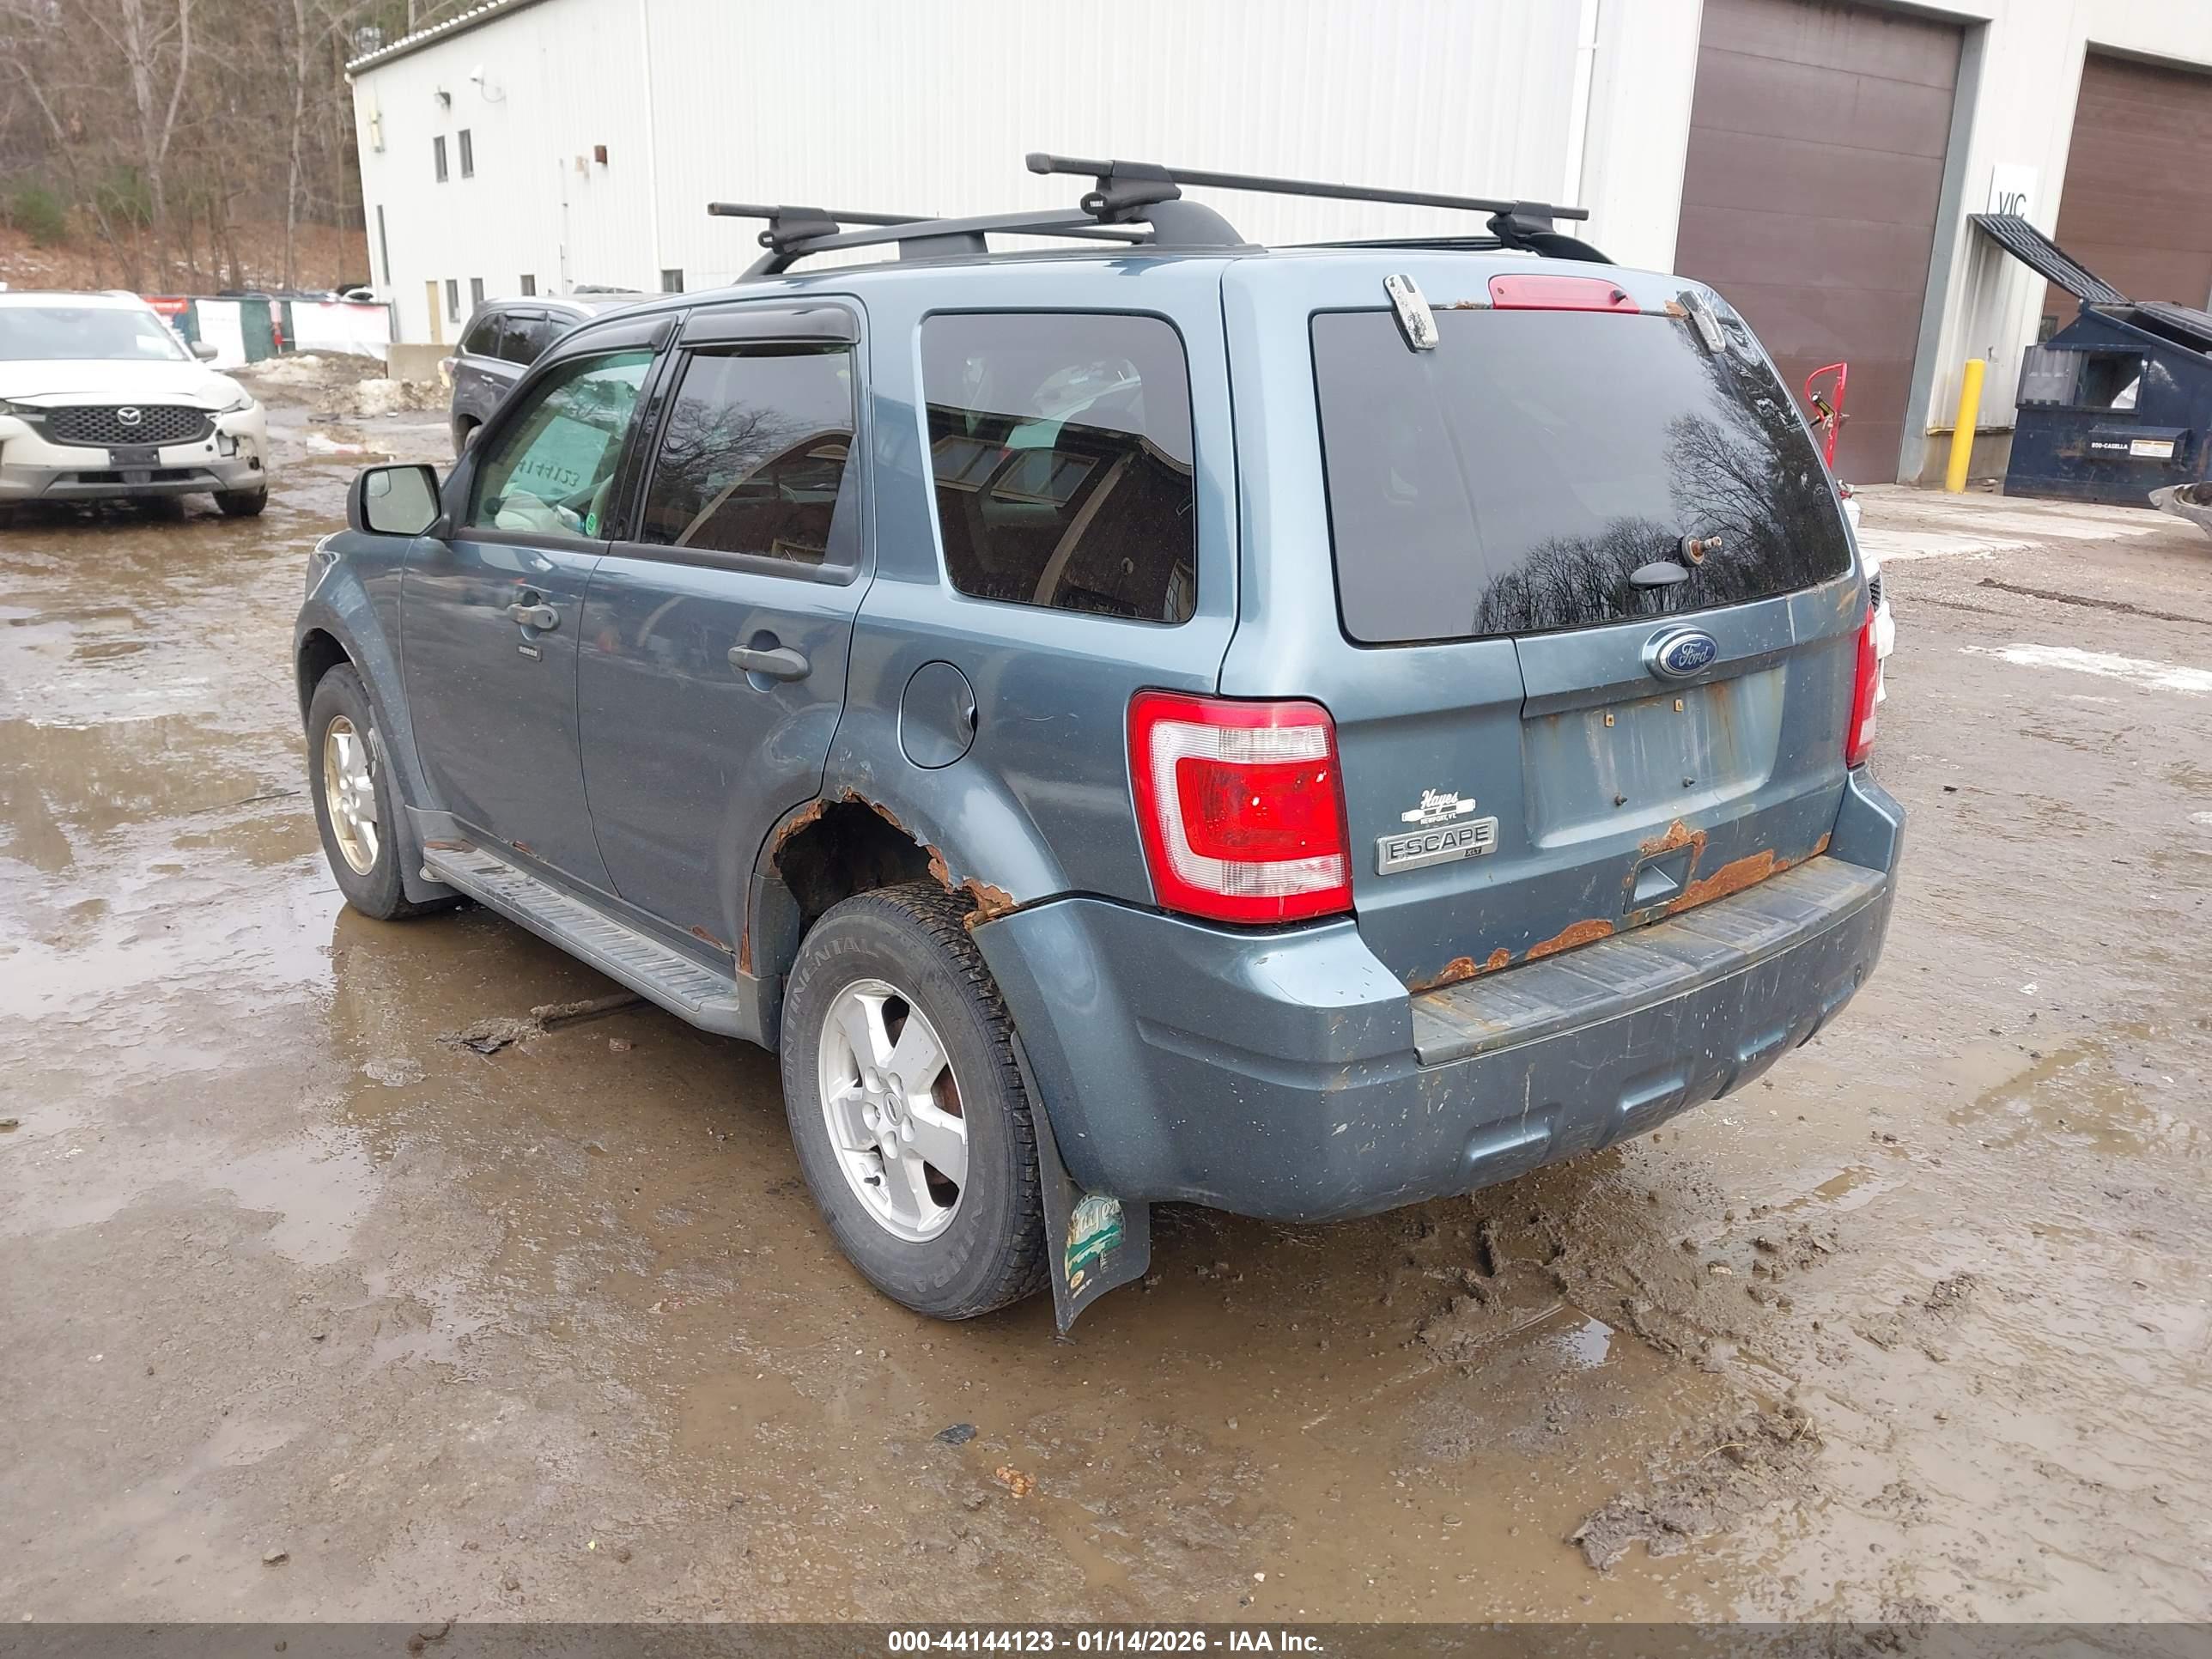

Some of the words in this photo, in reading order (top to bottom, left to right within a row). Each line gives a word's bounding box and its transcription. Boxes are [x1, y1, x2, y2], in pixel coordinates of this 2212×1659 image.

[1678, 642, 1711, 667] Ford
[1420, 788, 1459, 814] Hayes
[1389, 824, 1489, 860] ESCAPE
[1467, 848, 1481, 857] XLT
